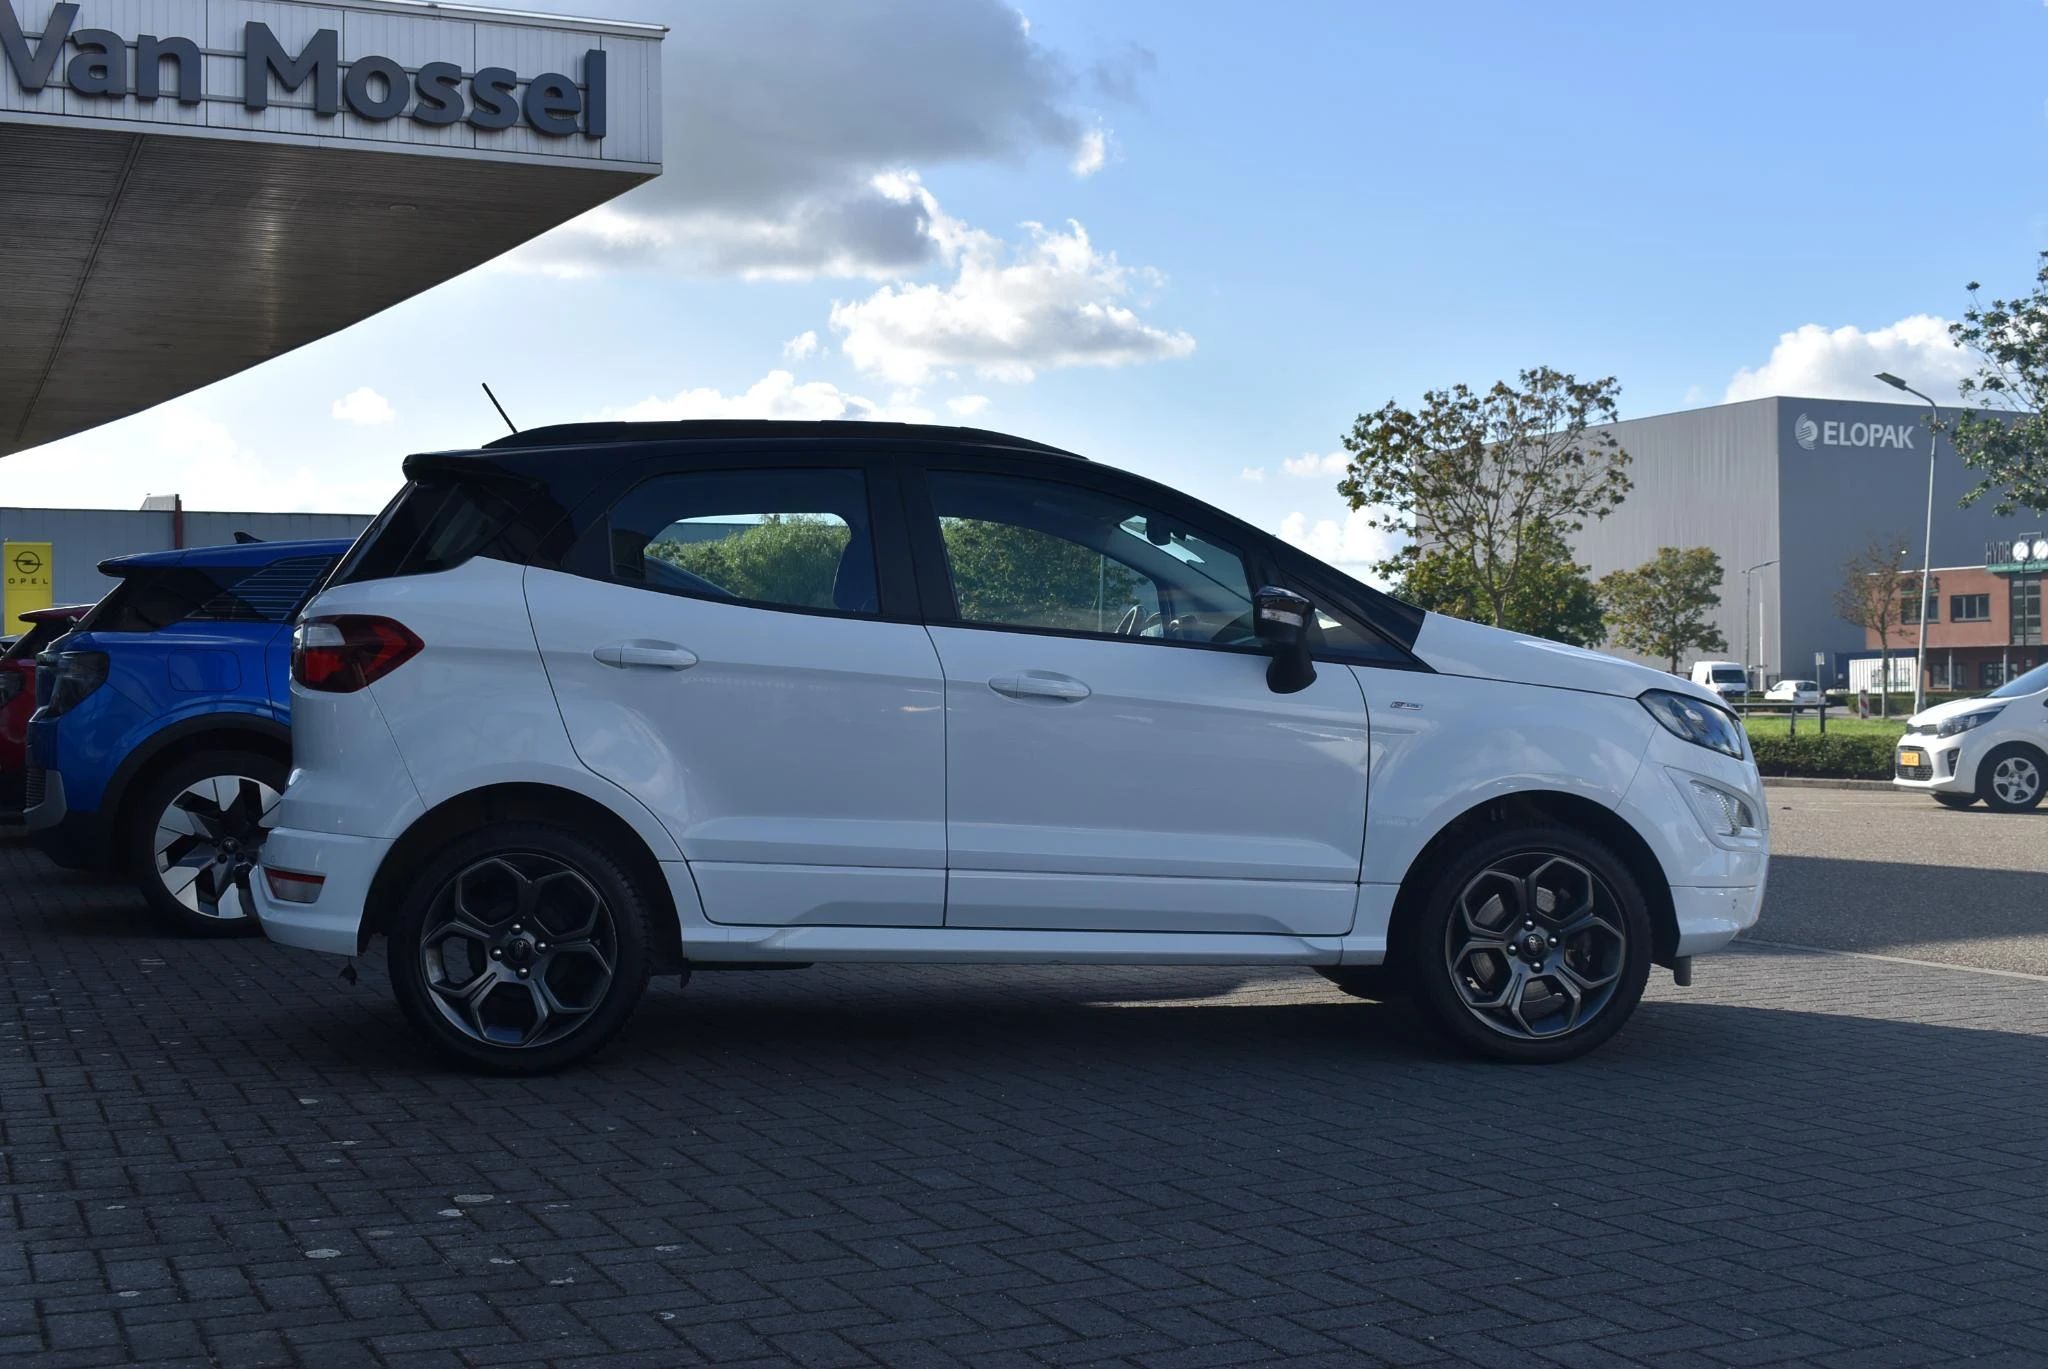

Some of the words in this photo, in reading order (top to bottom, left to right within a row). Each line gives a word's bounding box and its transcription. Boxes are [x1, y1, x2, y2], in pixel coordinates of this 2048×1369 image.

[0, 1, 202, 105] Van
[245, 21, 607, 140] Mossel
[1823, 421, 1914, 449] ELOPAK
